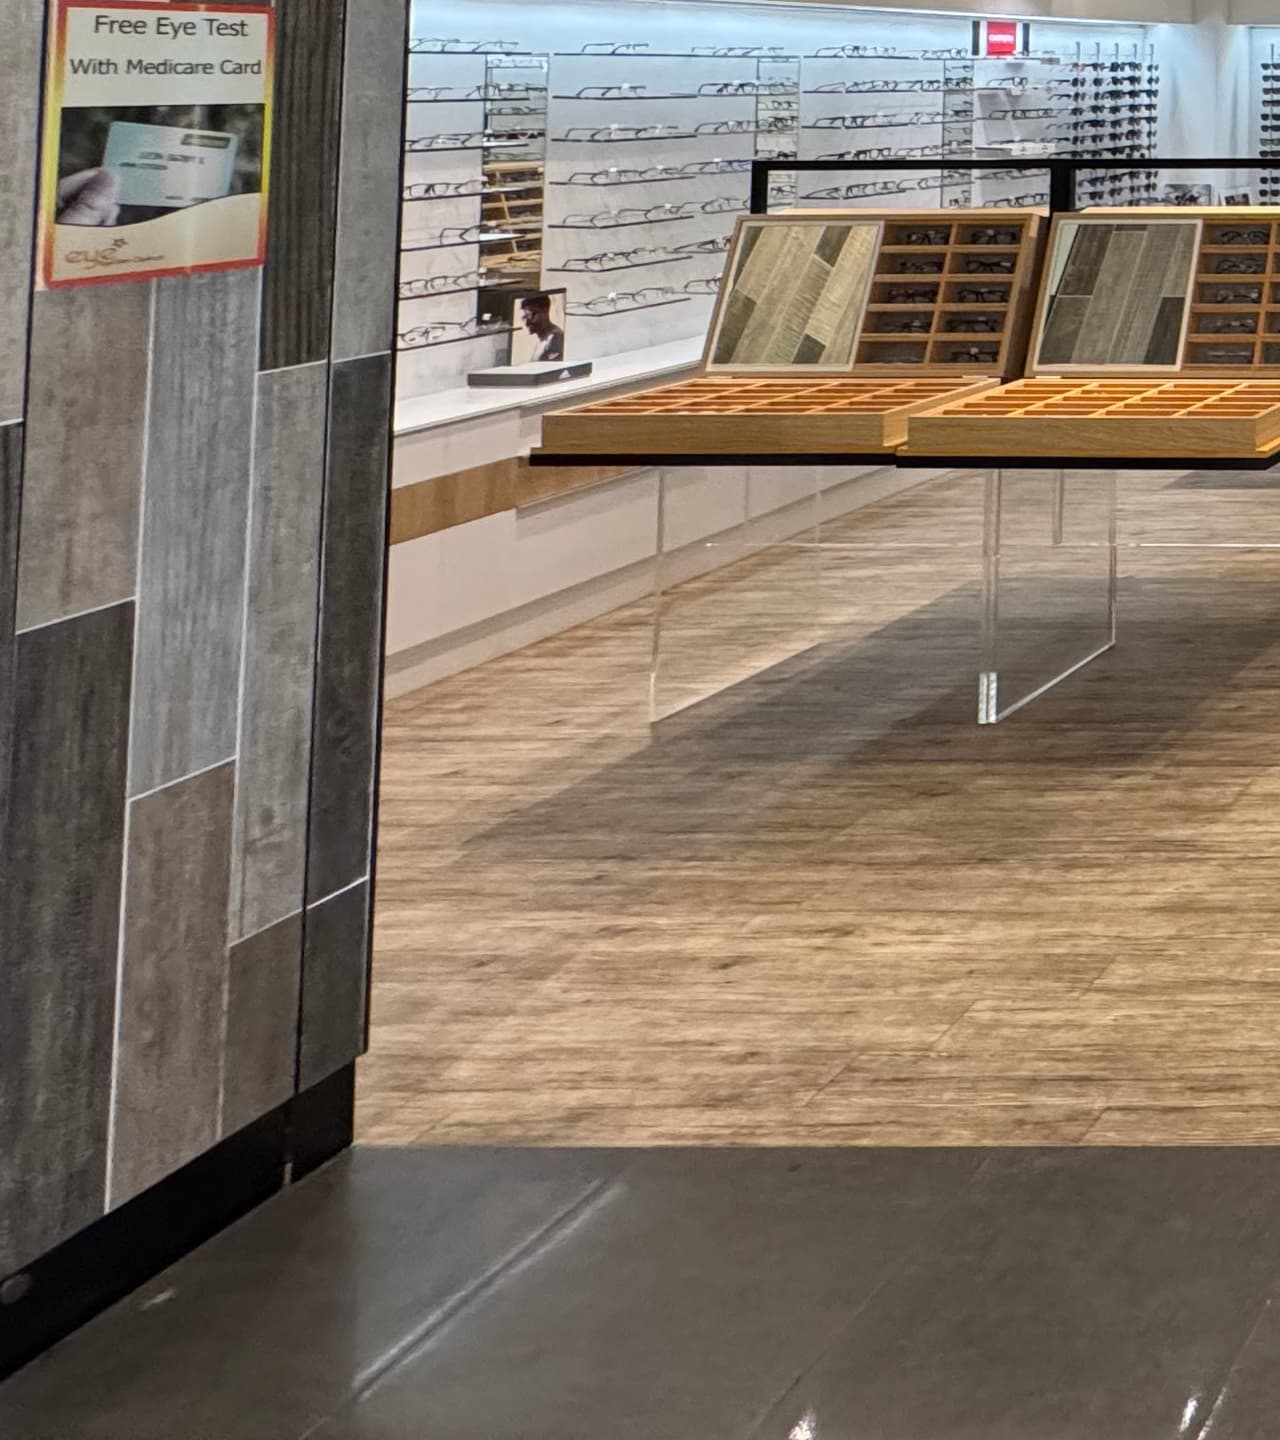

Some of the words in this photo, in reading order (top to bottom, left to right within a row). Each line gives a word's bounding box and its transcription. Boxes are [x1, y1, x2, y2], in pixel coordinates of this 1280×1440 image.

[94, 15, 148, 35] Free
[156, 17, 196, 39] Eye
[203, 18, 248, 37] Test
[70, 59, 118, 75] With
[125, 59, 214, 76] Medicare
[220, 60, 262, 75] Card
